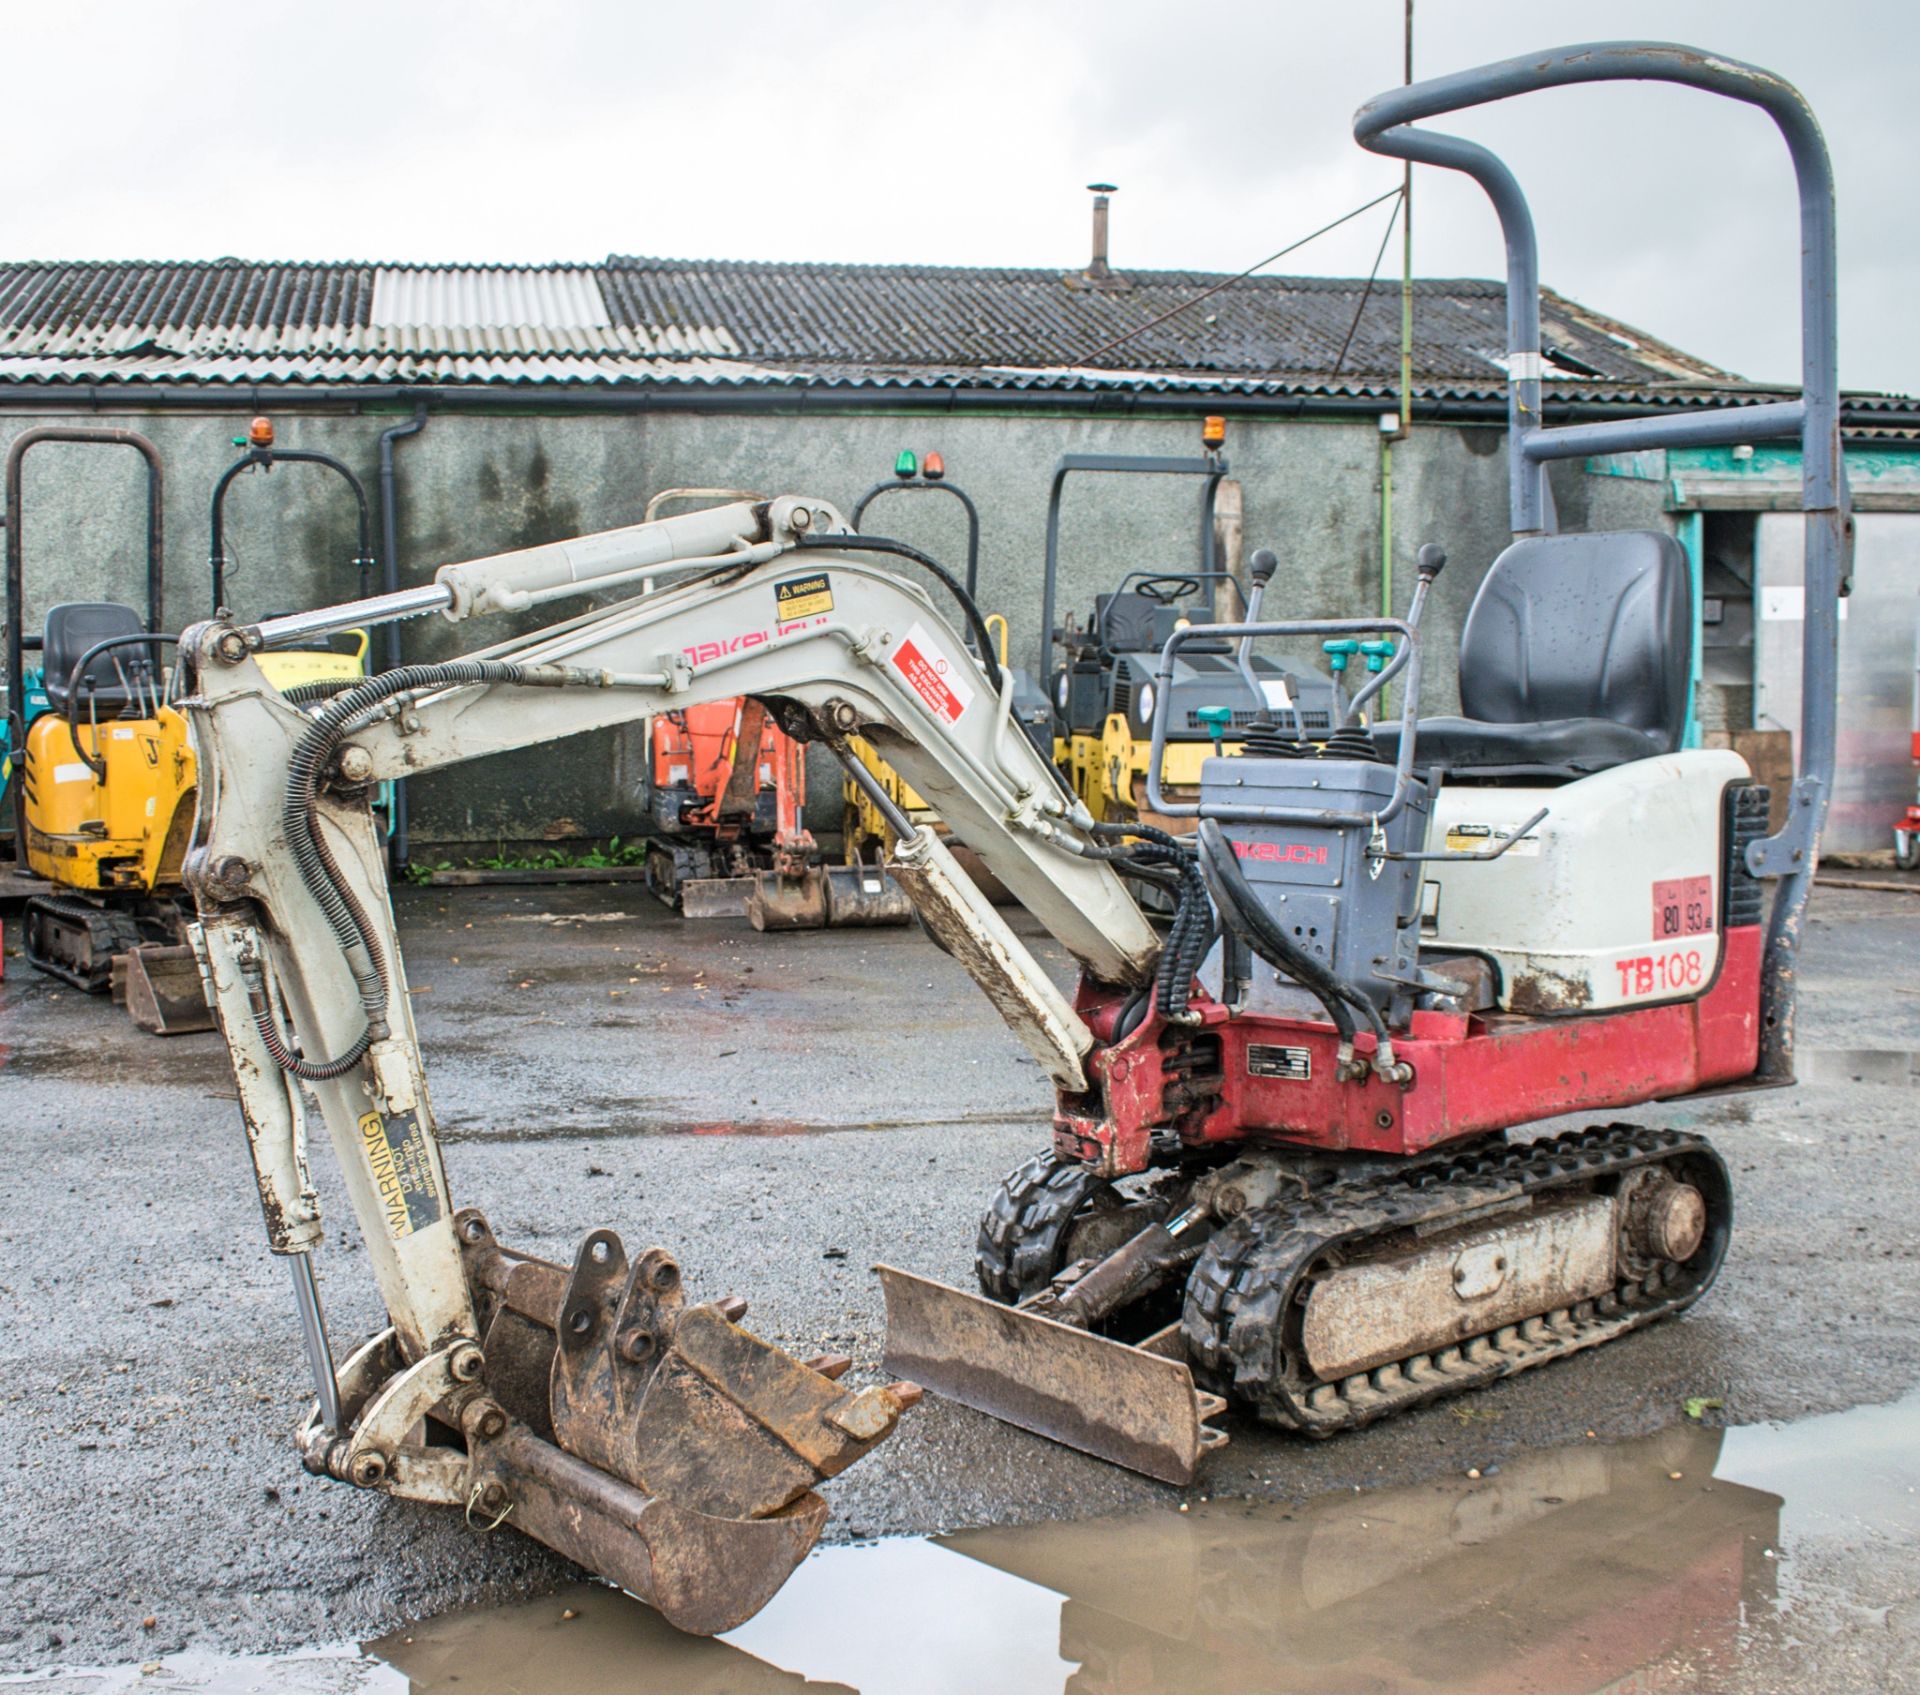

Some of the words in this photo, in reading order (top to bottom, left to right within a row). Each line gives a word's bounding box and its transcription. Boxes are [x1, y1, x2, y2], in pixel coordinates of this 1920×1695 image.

[792, 579, 825, 594] WARNING
[908, 659, 921, 675] THIS
[920, 673, 949, 709] EXCAVATOR
[908, 673, 918, 683] AS
[921, 688, 940, 709] CRANE
[918, 659, 927, 671] DO
[926, 670, 938, 683] NOT
[936, 682, 949, 697] USE
[1231, 840, 1328, 864] AKEUCHI
[1663, 905, 1679, 934] 80
[1687, 902, 1702, 931] 93
[1616, 950, 1701, 997] TB108
[409, 1122, 422, 1148] area
[362, 1119, 406, 1231] WARNING
[391, 1147, 406, 1172] NOT
[416, 1151, 436, 1198] swinging
[400, 1174, 413, 1194] DO
